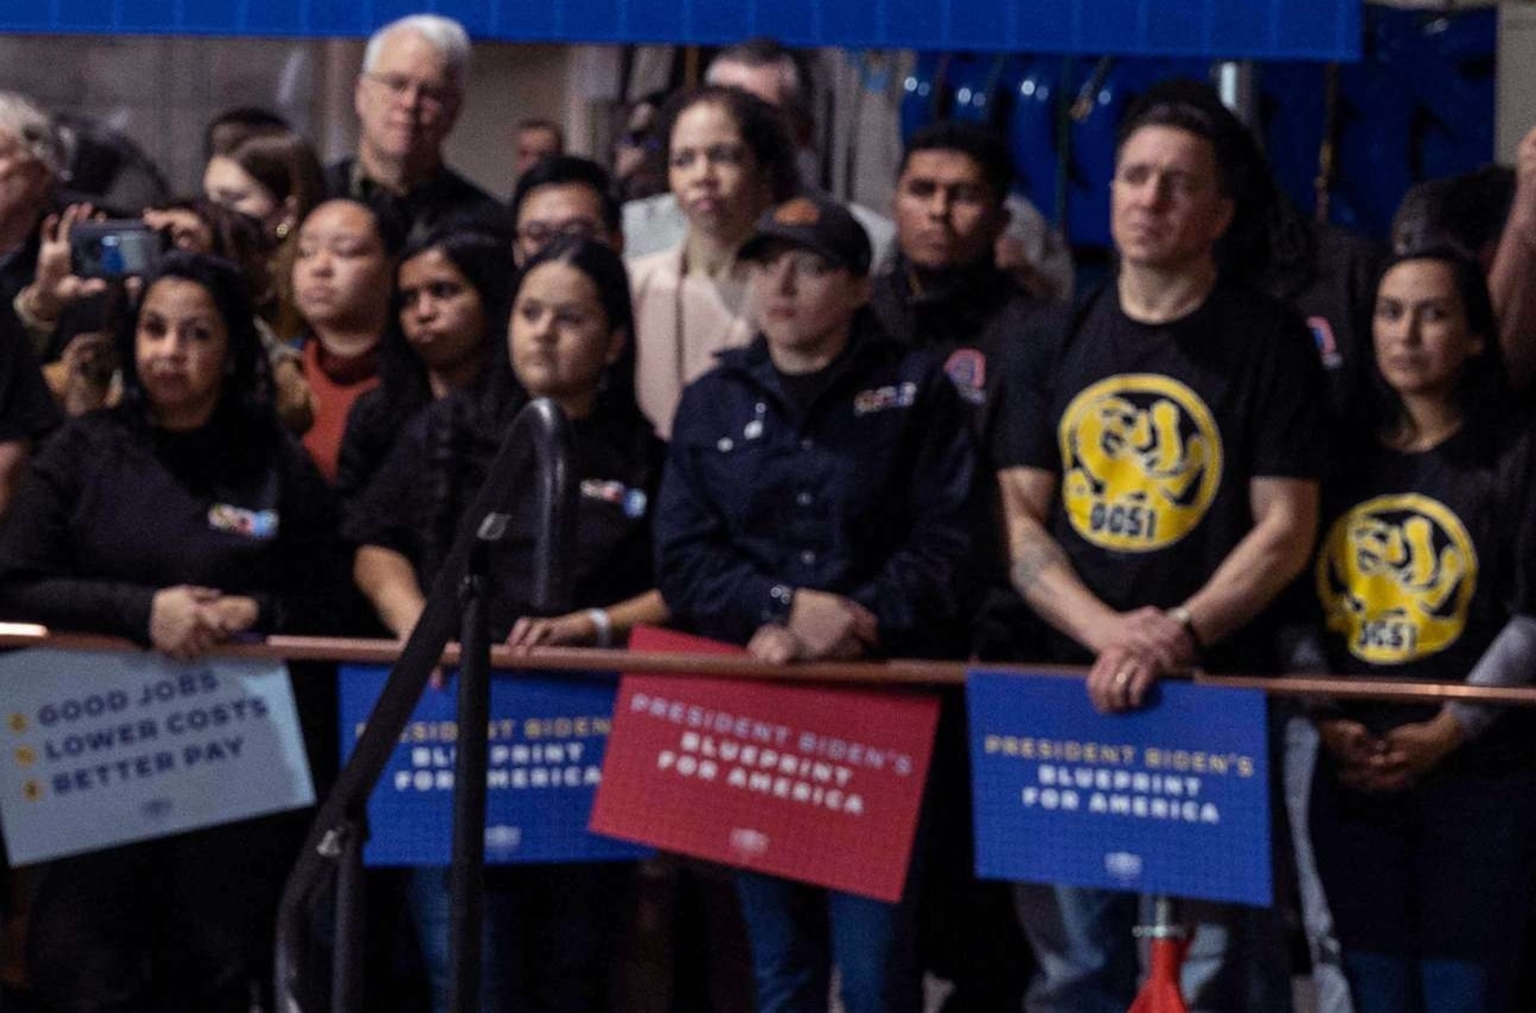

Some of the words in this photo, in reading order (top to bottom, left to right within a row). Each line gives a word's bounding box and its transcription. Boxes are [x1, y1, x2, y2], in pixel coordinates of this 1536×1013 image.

[38, 689, 129, 727] GOOD
[138, 670, 220, 708] JOBS
[630, 692, 790, 744] PRESIDENT
[45, 718, 159, 761] LOWER
[167, 695, 270, 736] COSTS
[984, 734, 1136, 764] PRESIDENT
[52, 751, 175, 796] BETTER
[183, 736, 246, 767] PAY
[394, 769, 455, 791] FOR
[657, 749, 718, 781] FOR
[728, 767, 864, 816] AMERICA
[680, 731, 852, 787] BLUEPRINT
[1038, 764, 1201, 796] BLUEPRINT
[1022, 786, 1080, 811] FOR
[1088, 791, 1220, 824] AMERICA
